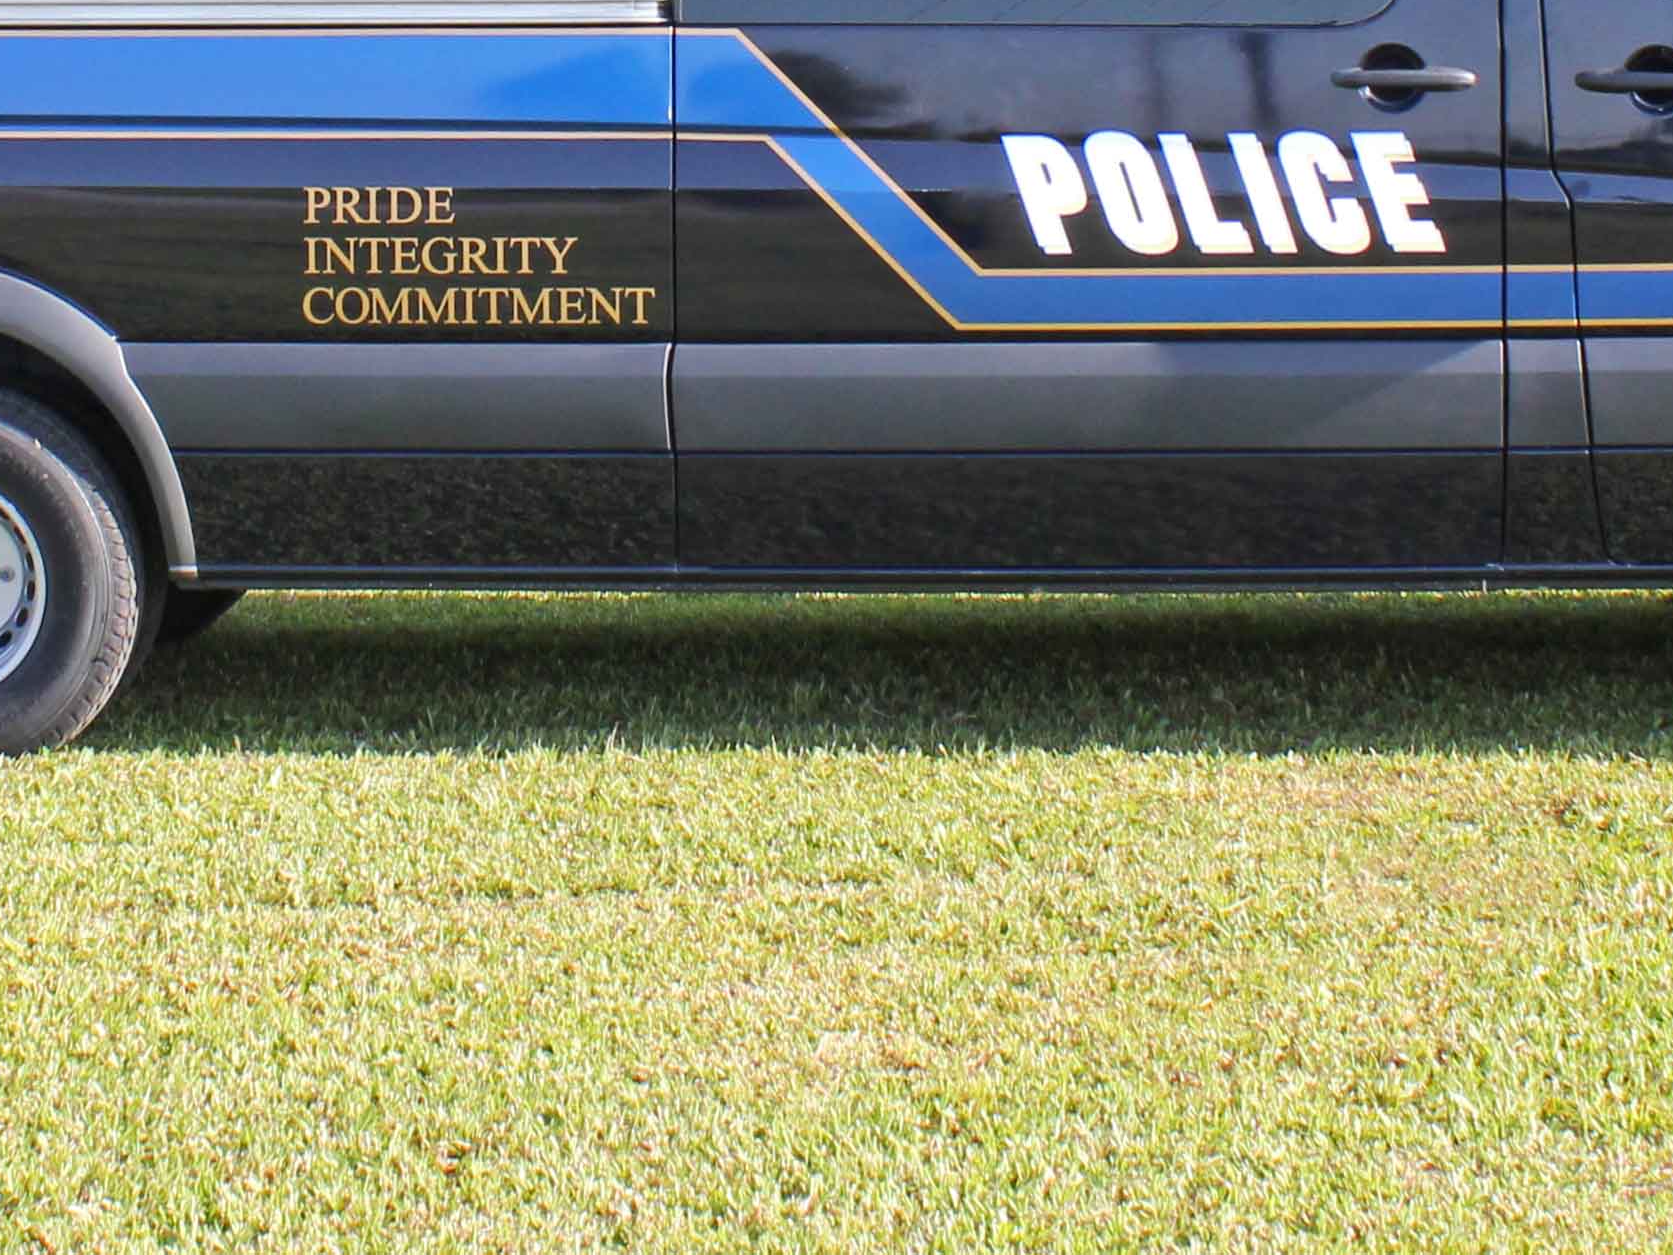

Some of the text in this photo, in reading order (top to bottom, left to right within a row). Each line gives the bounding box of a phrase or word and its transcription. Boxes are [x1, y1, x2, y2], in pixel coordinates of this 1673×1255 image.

[302, 185, 457, 225] PRIDE
[1000, 130, 1448, 256] POLICE
[302, 235, 579, 276] INTEGRITY
[301, 285, 657, 326] COMMITMENT
